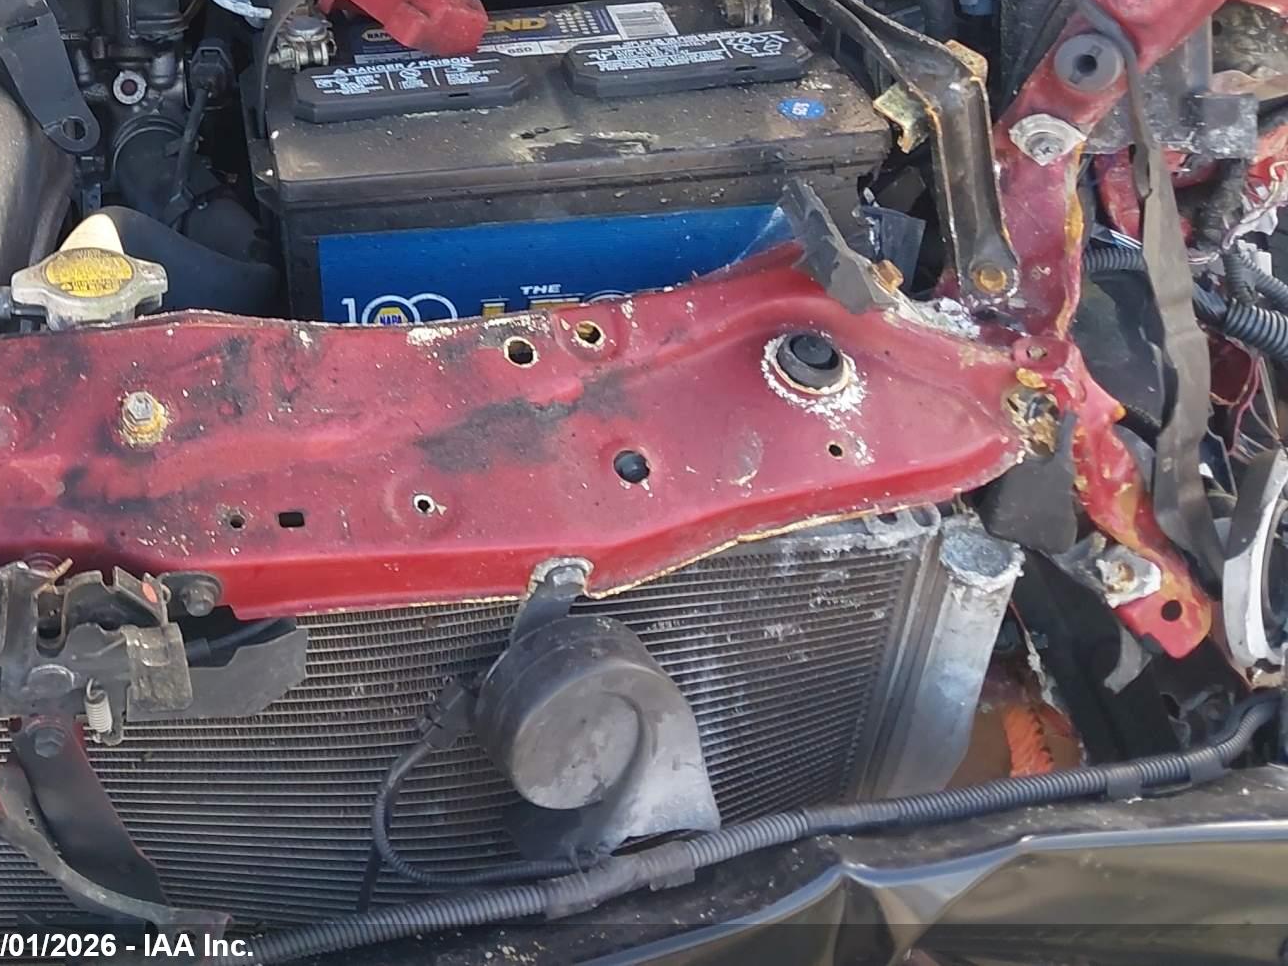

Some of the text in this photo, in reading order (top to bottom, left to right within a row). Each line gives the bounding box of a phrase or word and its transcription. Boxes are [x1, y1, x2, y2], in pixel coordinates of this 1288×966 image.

[347, 62, 405, 75] DANGER
[418, 56, 471, 68] POISON
[519, 283, 562, 296] THE
